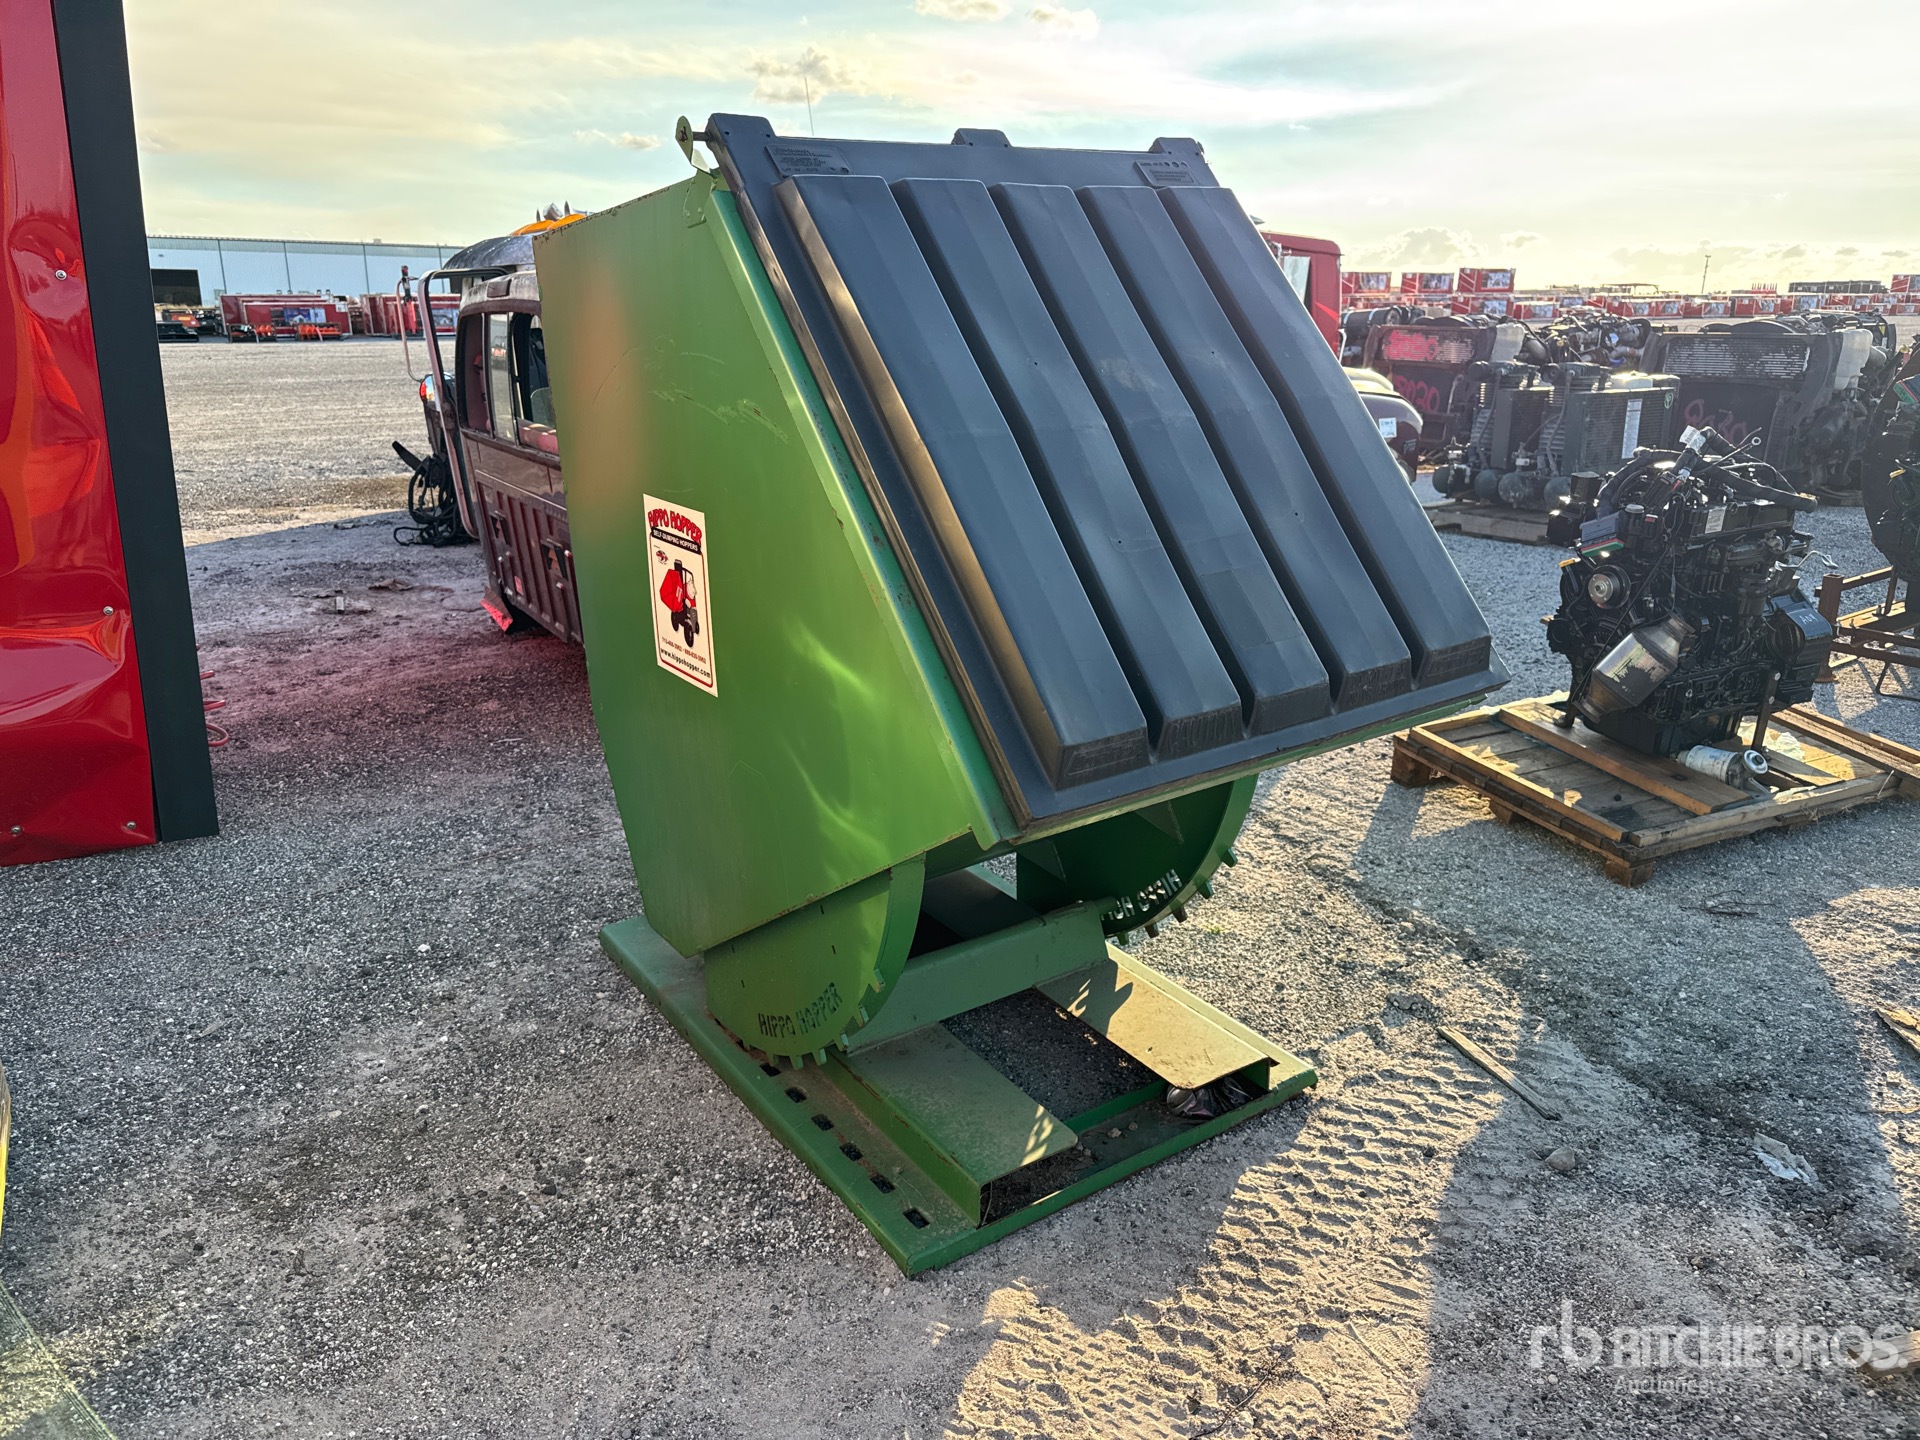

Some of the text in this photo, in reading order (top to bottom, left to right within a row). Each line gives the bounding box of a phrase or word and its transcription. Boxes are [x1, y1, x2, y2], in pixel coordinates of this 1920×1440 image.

[648, 508, 702, 547] HIPPO HOPPER
[653, 529, 698, 552] SELF-DUMPING HOPPERS
[661, 648, 711, 679] www.hippohopper.com
[758, 982, 843, 1038] HIPPO HOPPER
